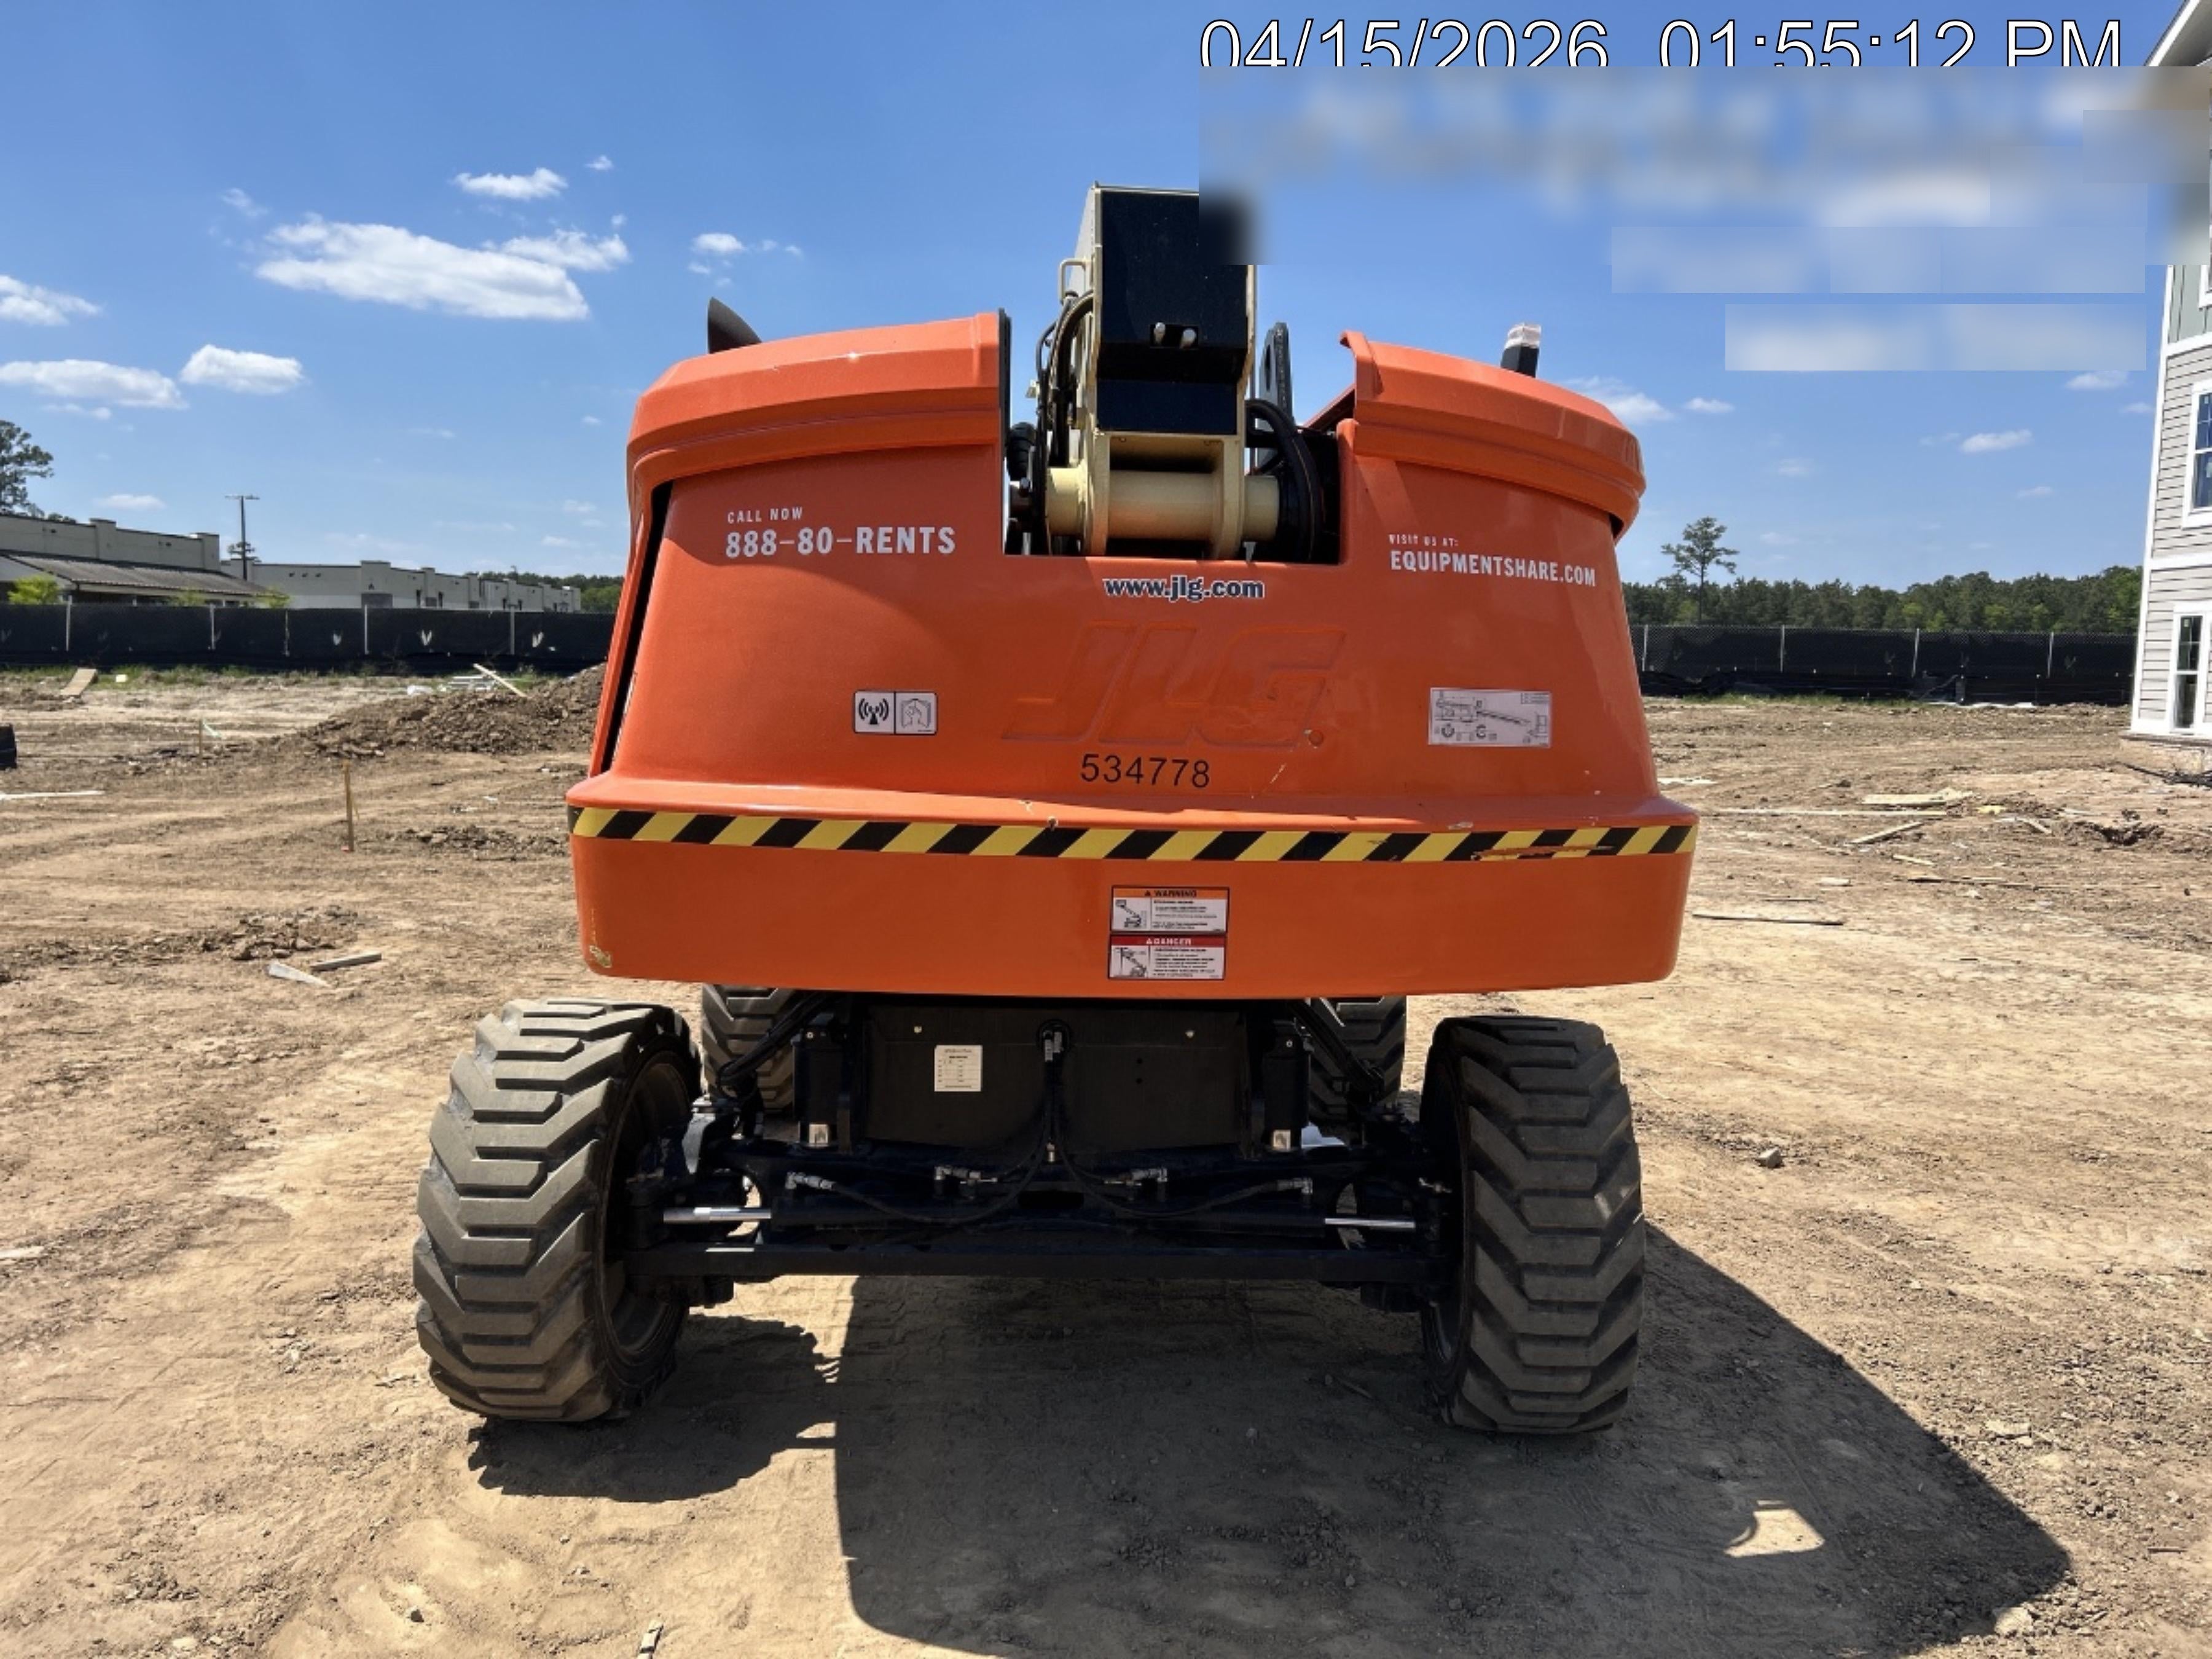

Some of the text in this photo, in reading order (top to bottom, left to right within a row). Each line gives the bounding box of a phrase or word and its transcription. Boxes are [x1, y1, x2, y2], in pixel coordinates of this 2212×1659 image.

[727, 506, 803, 524] CALL NOW
[725, 526, 956, 559] 888-80-RENTS
[1388, 534, 1418, 545] VISIT
[1390, 550, 1596, 587] EQUIPMENTSHARE.COM
[1102, 575, 1266, 603] www.jlg.com
[1080, 753, 1210, 788] 534778
